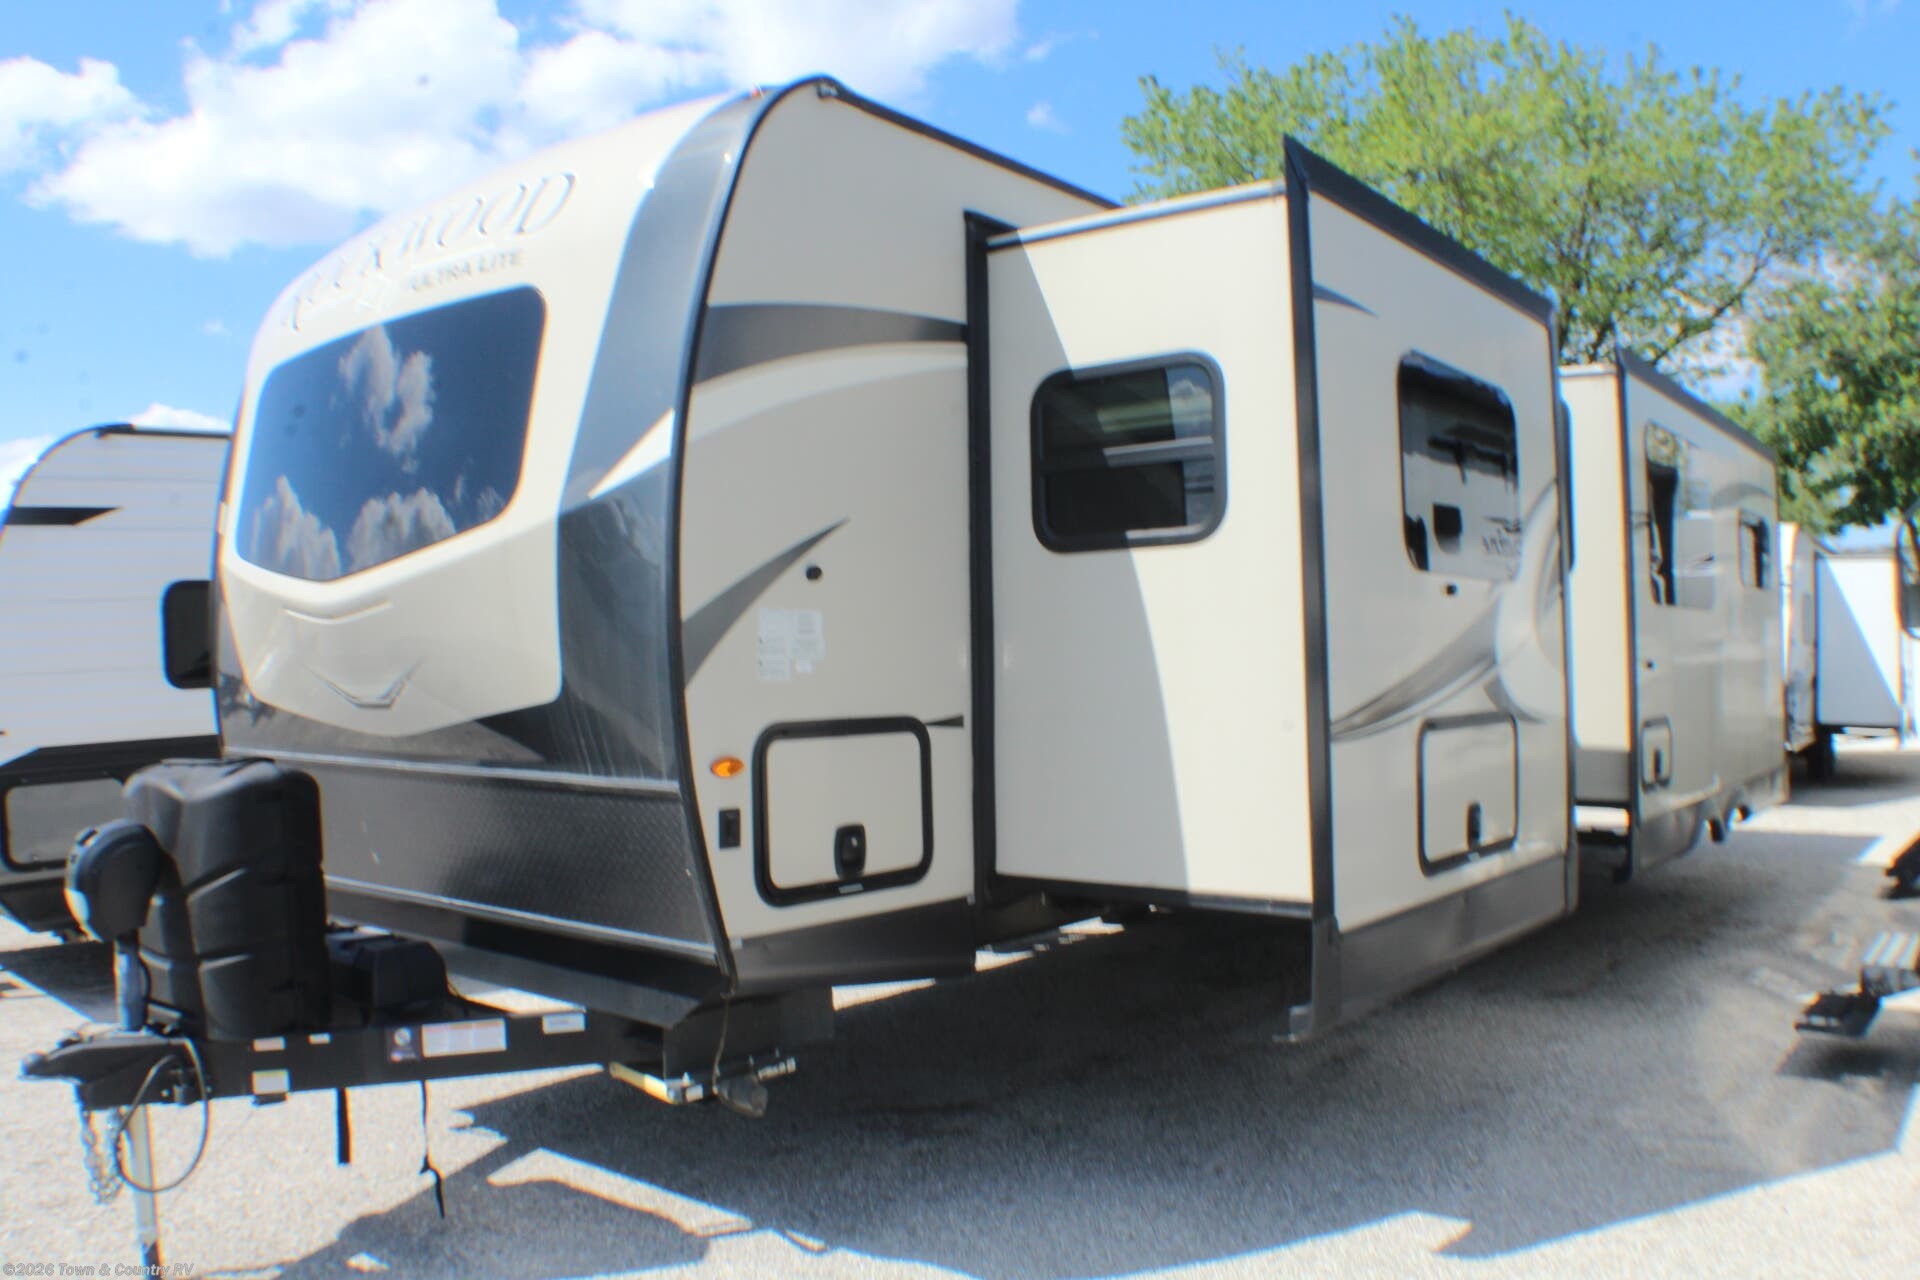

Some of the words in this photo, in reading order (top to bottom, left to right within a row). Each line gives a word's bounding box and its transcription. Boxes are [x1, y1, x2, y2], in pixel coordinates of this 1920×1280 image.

[282, 172, 578, 331] KWOOD
[408, 262, 472, 292] ULTRA
[478, 248, 523, 273] LITE
